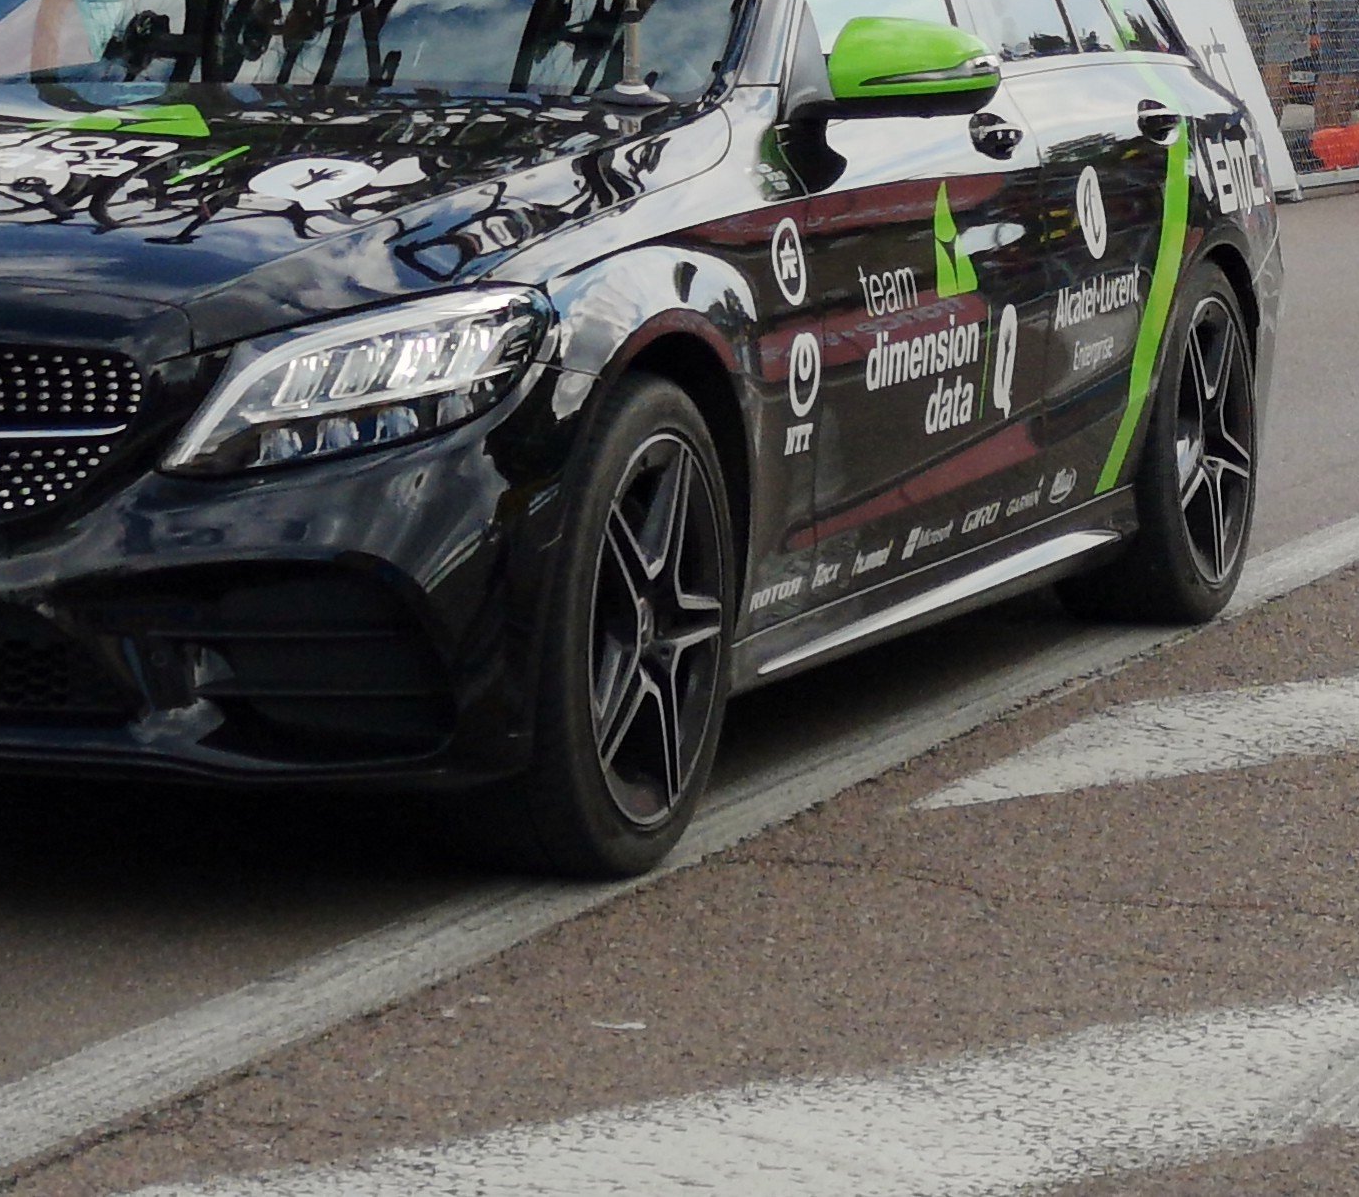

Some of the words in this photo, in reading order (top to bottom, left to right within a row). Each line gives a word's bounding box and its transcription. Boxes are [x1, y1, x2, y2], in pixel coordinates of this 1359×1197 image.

[1206, 137, 1266, 213] BMC
[858, 265, 918, 317] team
[866, 314, 980, 391] dimension
[925, 375, 974, 435] data
[784, 423, 814, 456] NTT
[749, 576, 803, 614] ROTOR
[961, 501, 1001, 534] GIRO
